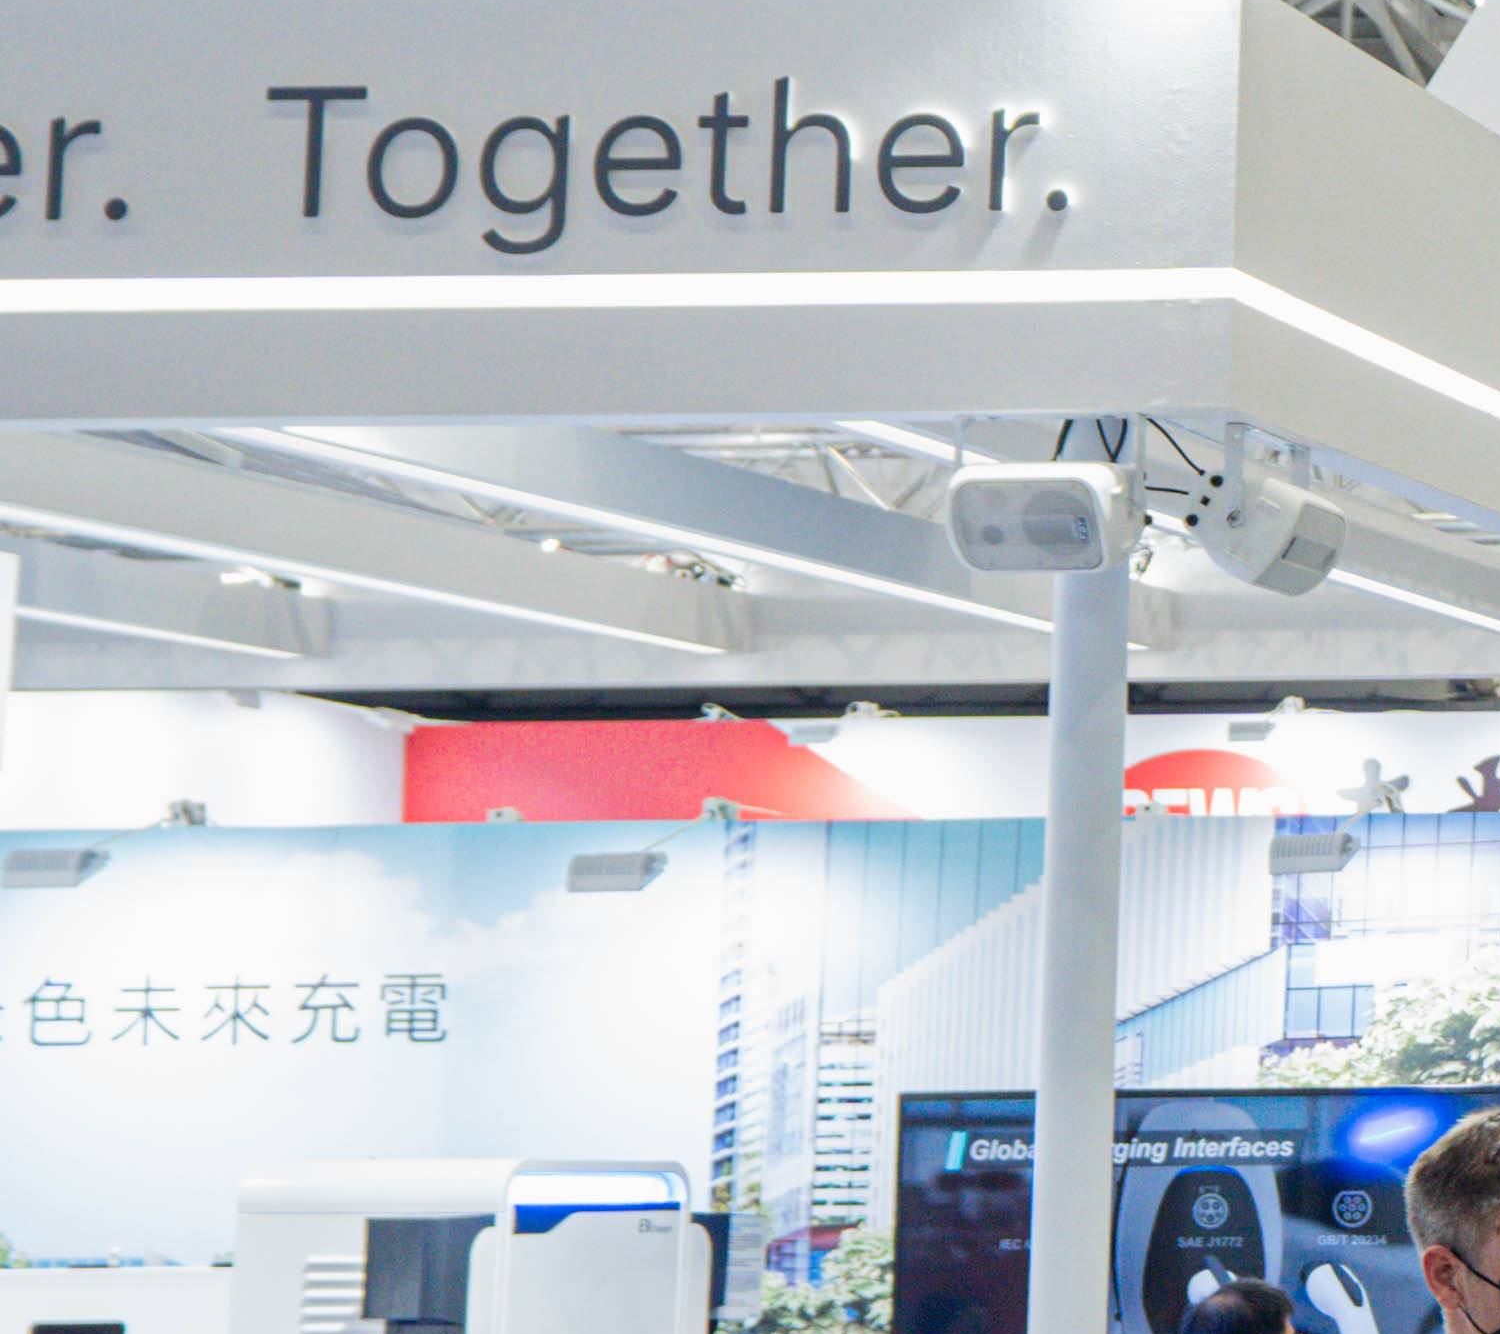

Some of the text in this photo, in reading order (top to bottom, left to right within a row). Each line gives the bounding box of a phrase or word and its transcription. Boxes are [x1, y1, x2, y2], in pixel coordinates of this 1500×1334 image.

[266, 75, 1070, 255] Together.
[968, 1138, 1036, 1161] Globa
[1173, 1136, 1295, 1158] Interfaces
